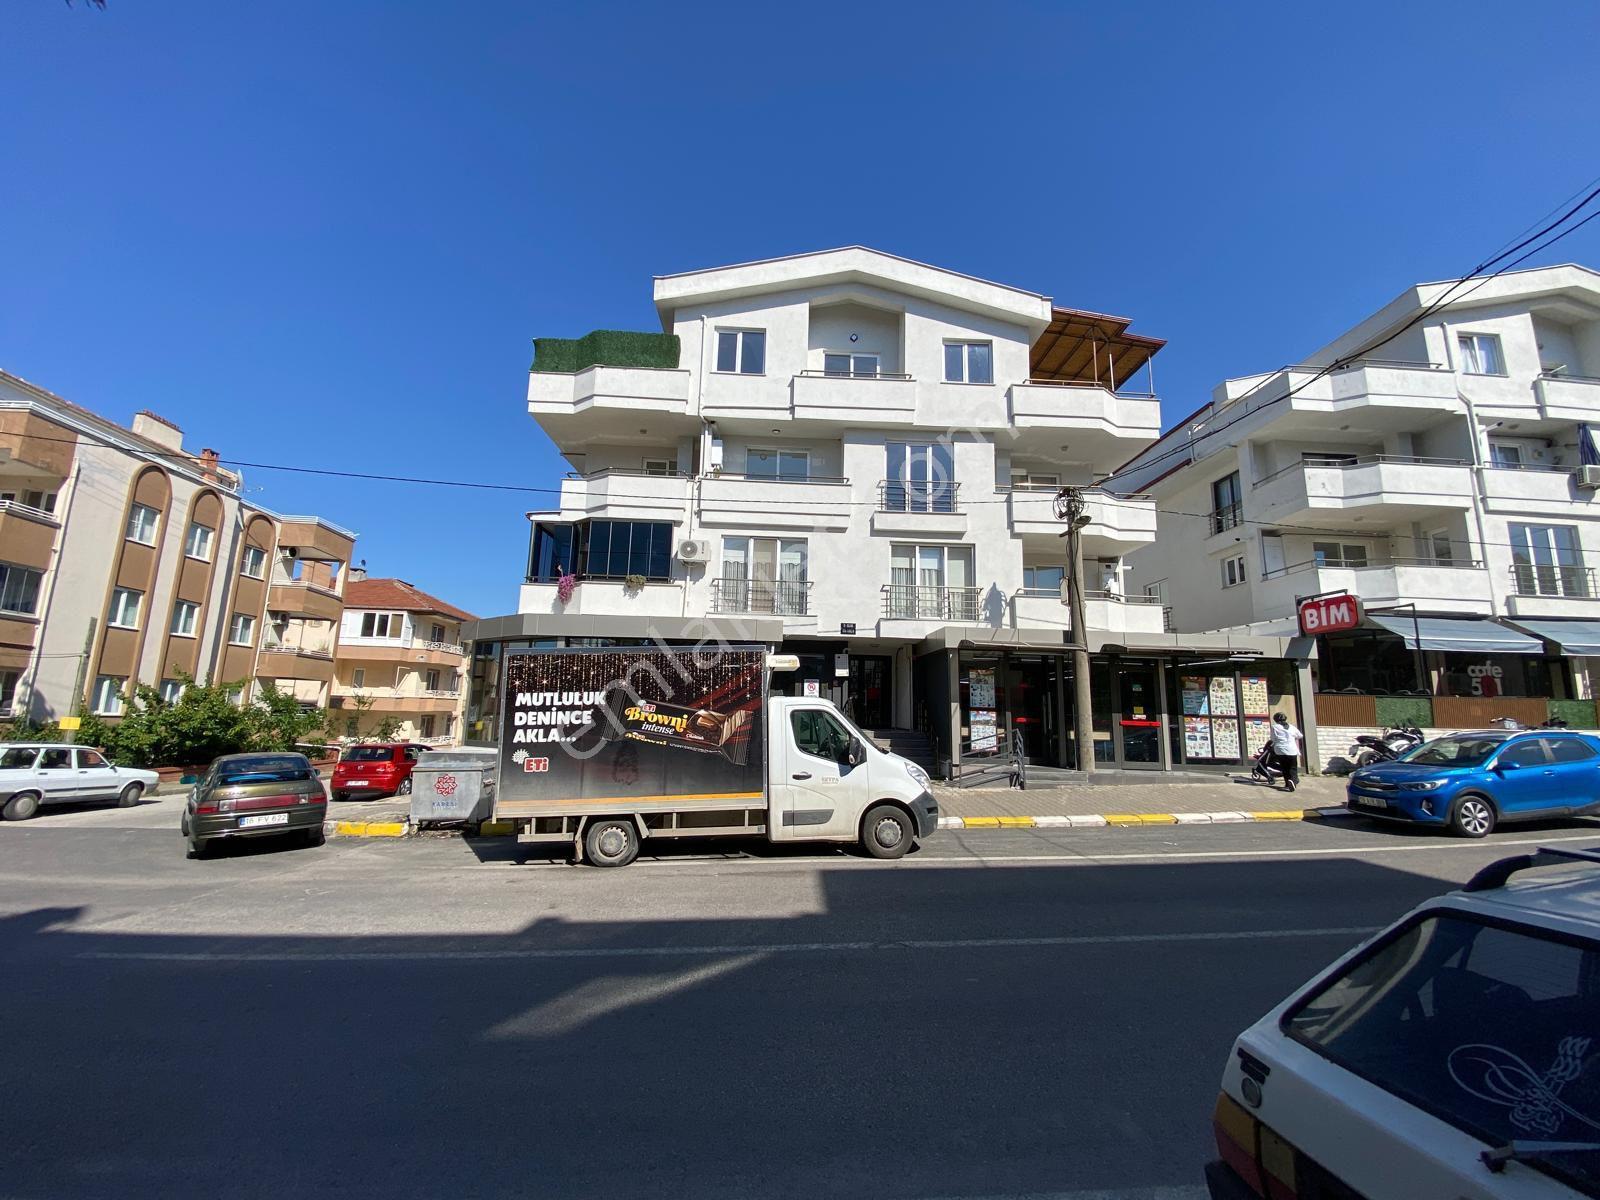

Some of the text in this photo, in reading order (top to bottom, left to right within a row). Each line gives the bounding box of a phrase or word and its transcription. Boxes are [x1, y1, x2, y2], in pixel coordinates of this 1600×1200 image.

[1305, 601, 1351, 630] BİM
[1467, 660, 1503, 678] cafe
[515, 691, 606, 707] MUTLULUK
[514, 706, 592, 726] DENİNCE
[624, 706, 688, 732] Browni
[512, 728, 577, 743] AKLA...
[641, 721, 675, 735] intense
